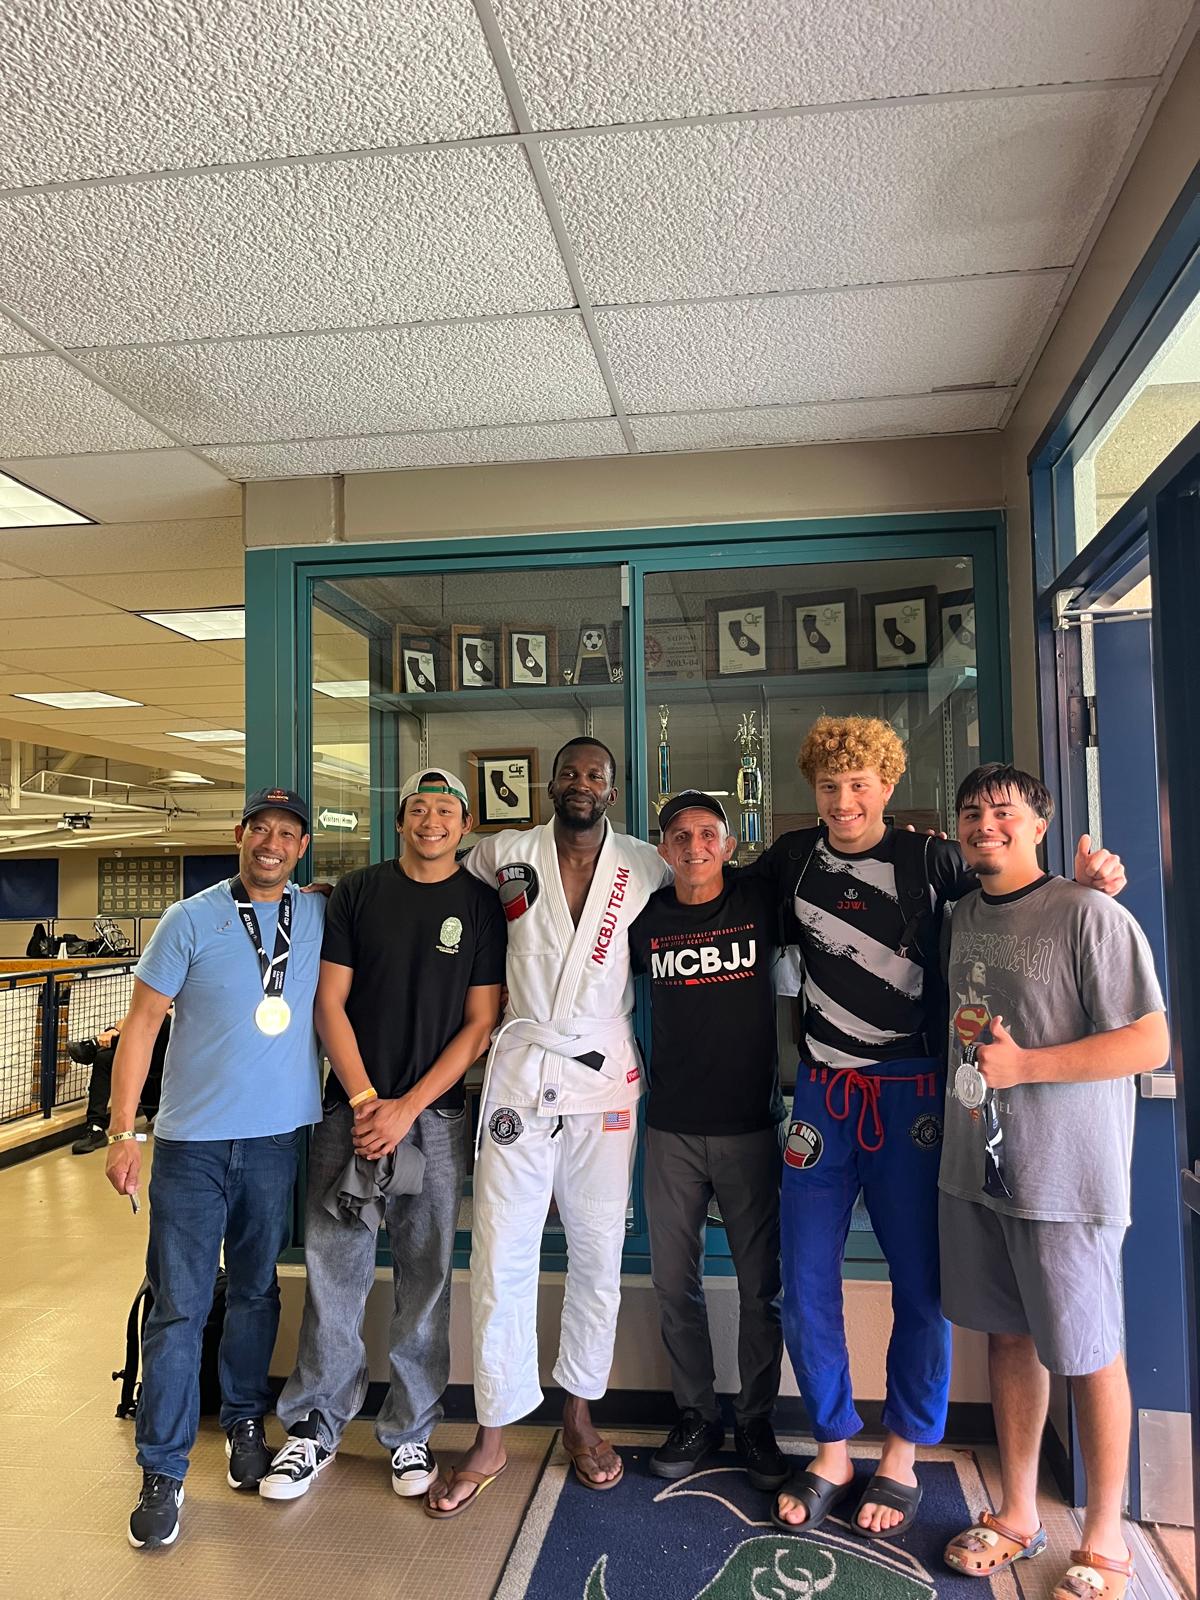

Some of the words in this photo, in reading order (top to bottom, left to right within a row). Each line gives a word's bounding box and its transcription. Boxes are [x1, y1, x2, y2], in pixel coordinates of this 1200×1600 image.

[591, 911, 618, 966] MCBJJ
[607, 866, 631, 909] TEAM
[651, 940, 757, 979] MCBJJ
